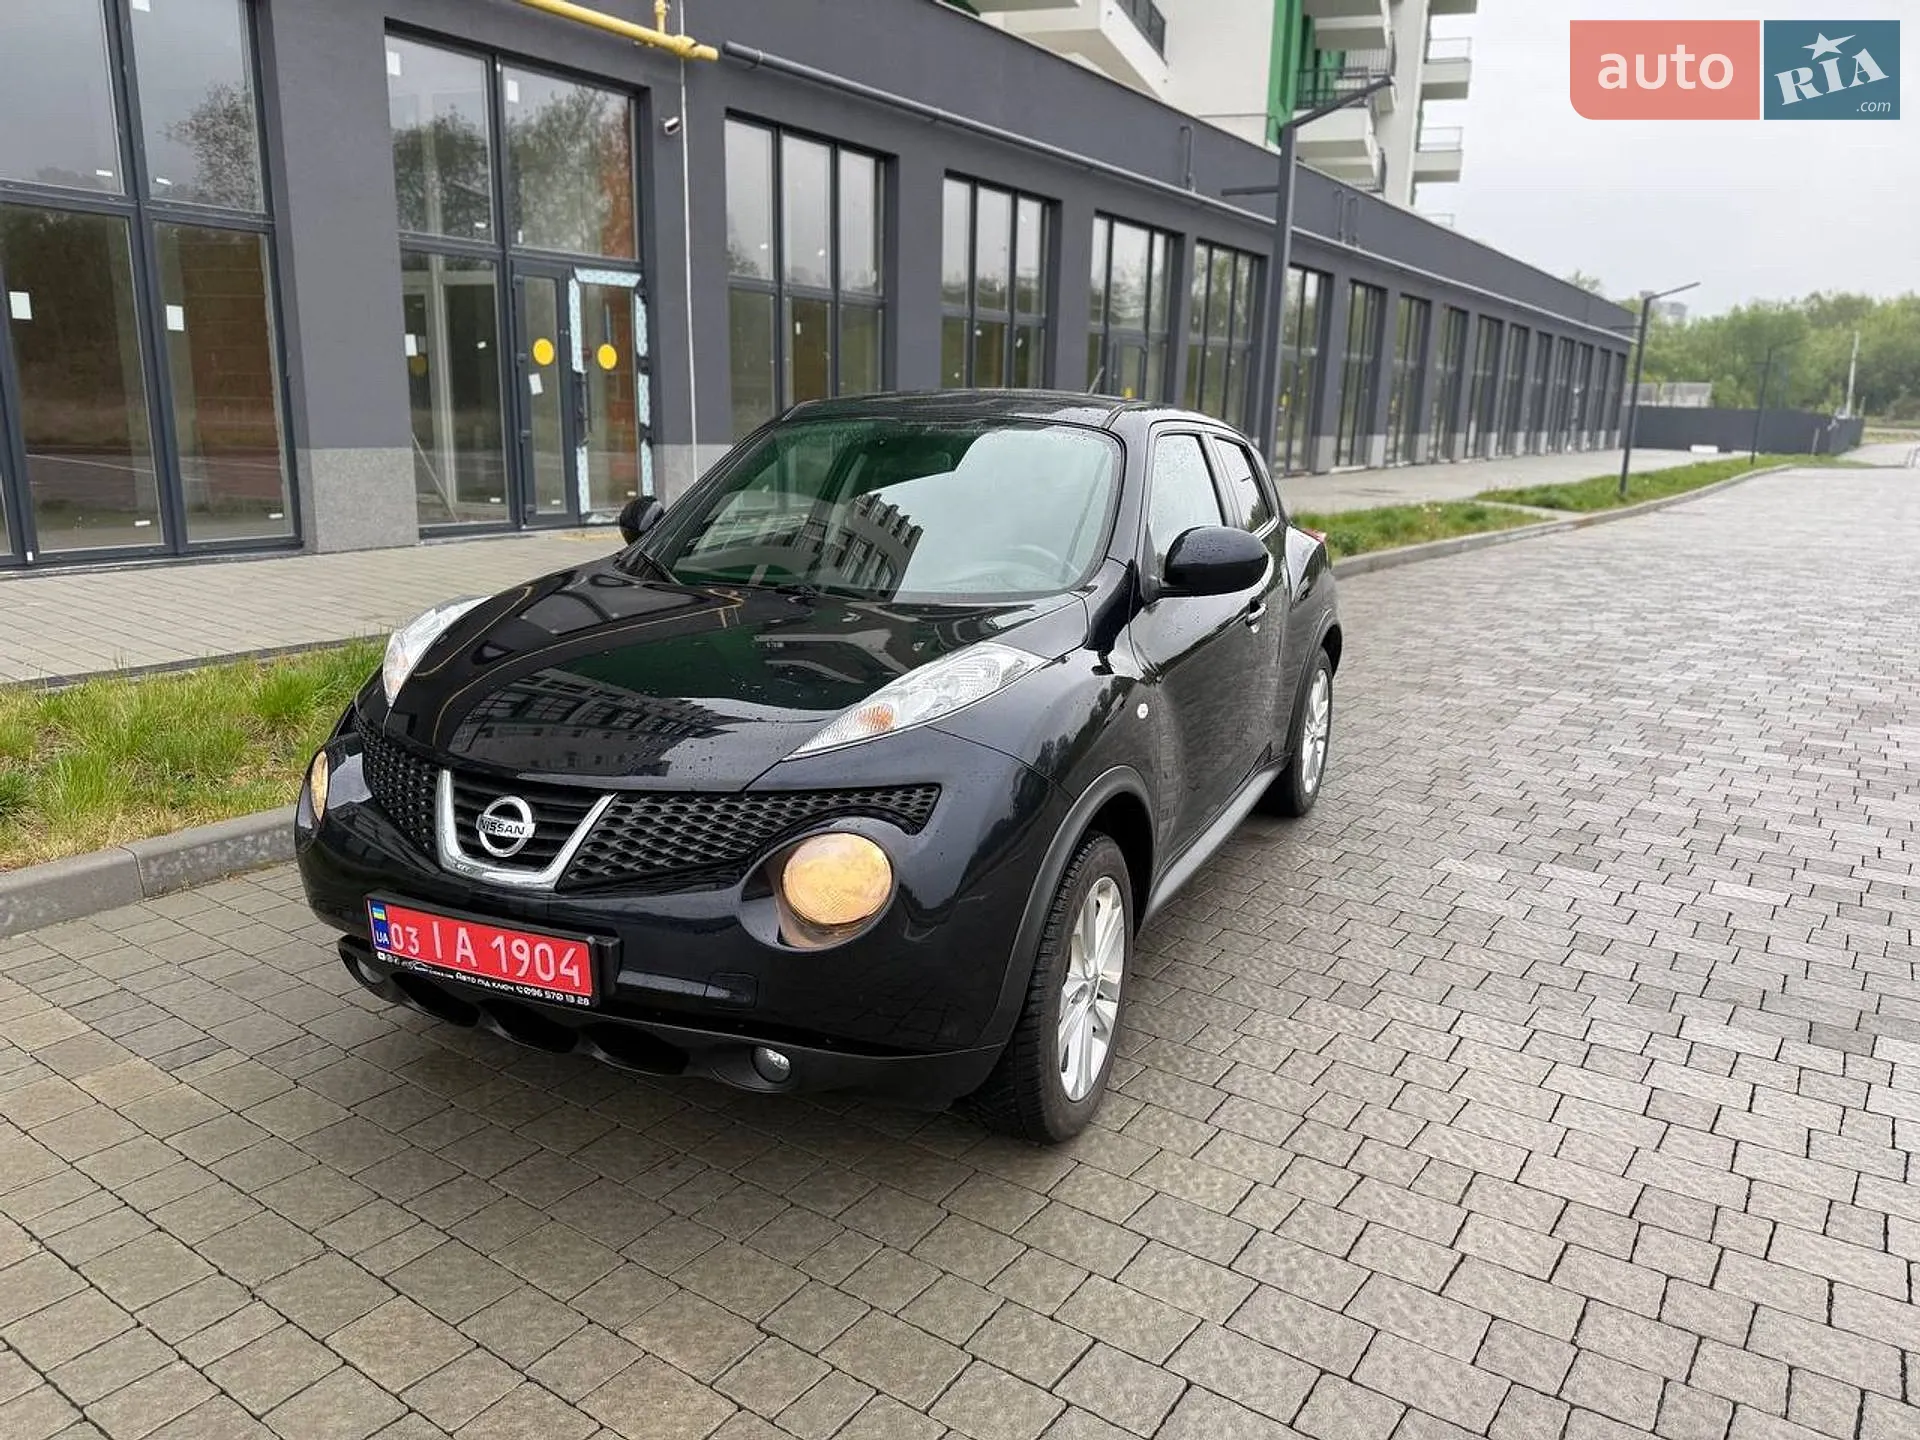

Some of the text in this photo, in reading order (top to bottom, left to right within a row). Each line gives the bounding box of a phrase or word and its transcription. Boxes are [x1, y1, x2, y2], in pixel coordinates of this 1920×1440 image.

[480, 818, 525, 835] NISSAN
[376, 931, 390, 945] UA
[391, 922, 420, 955] 03
[491, 935, 581, 987] 1904
